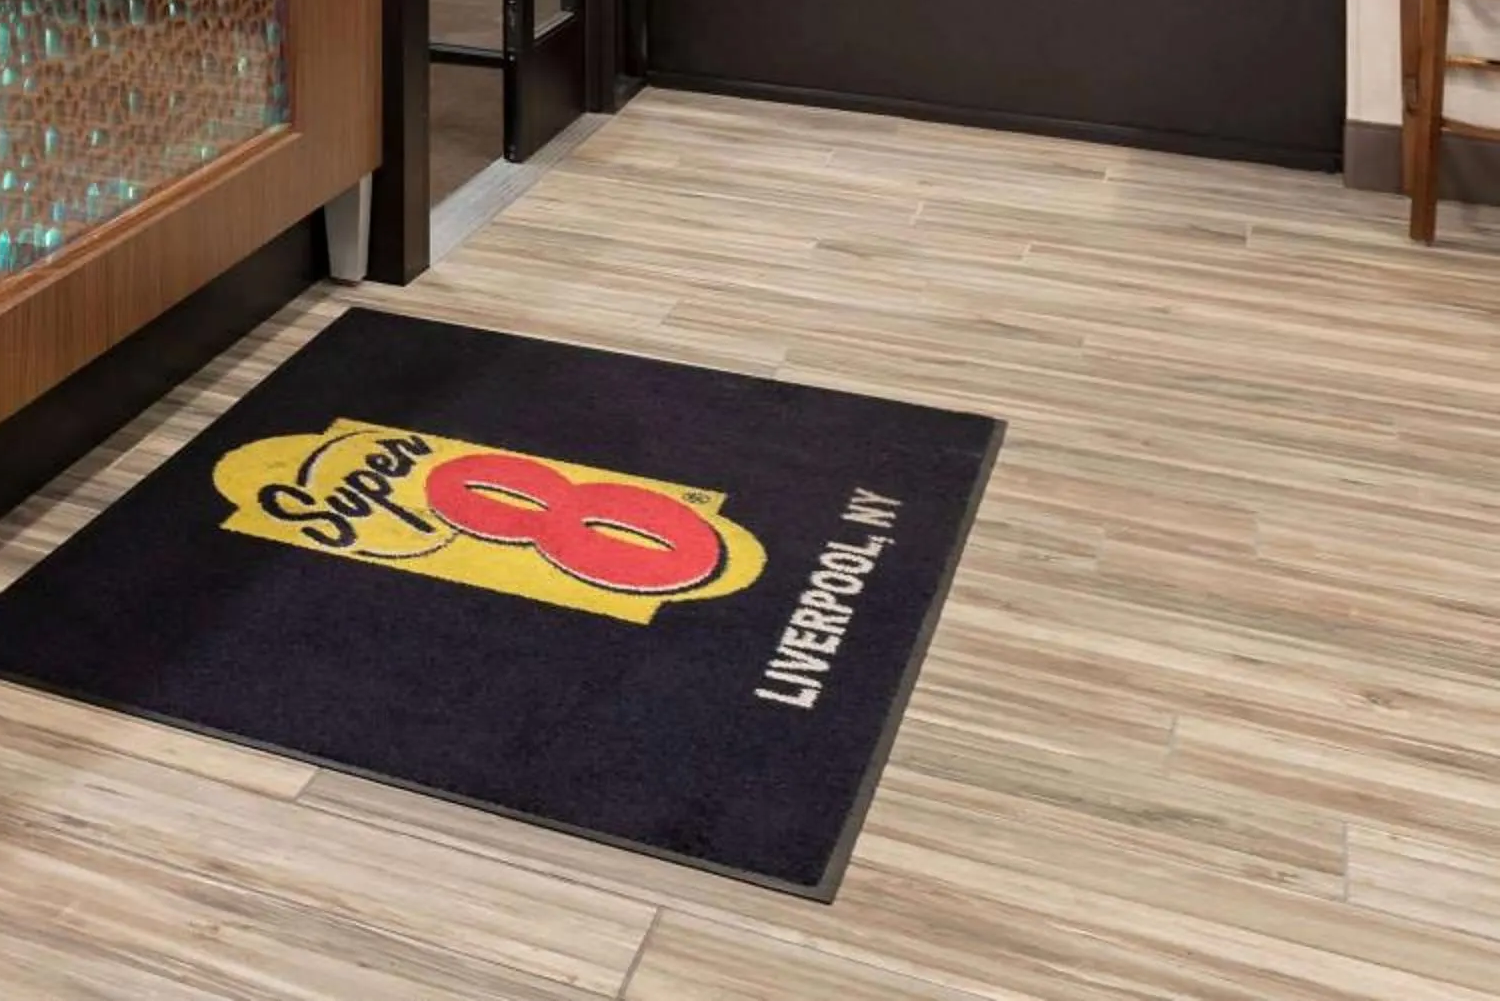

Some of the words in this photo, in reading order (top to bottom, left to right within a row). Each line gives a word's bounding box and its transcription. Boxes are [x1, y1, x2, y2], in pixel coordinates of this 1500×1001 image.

[257, 434, 436, 548] Super
[424, 453, 728, 595] 8
[754, 534, 897, 709] LIVERPOOL,
[840, 486, 903, 529] NY
